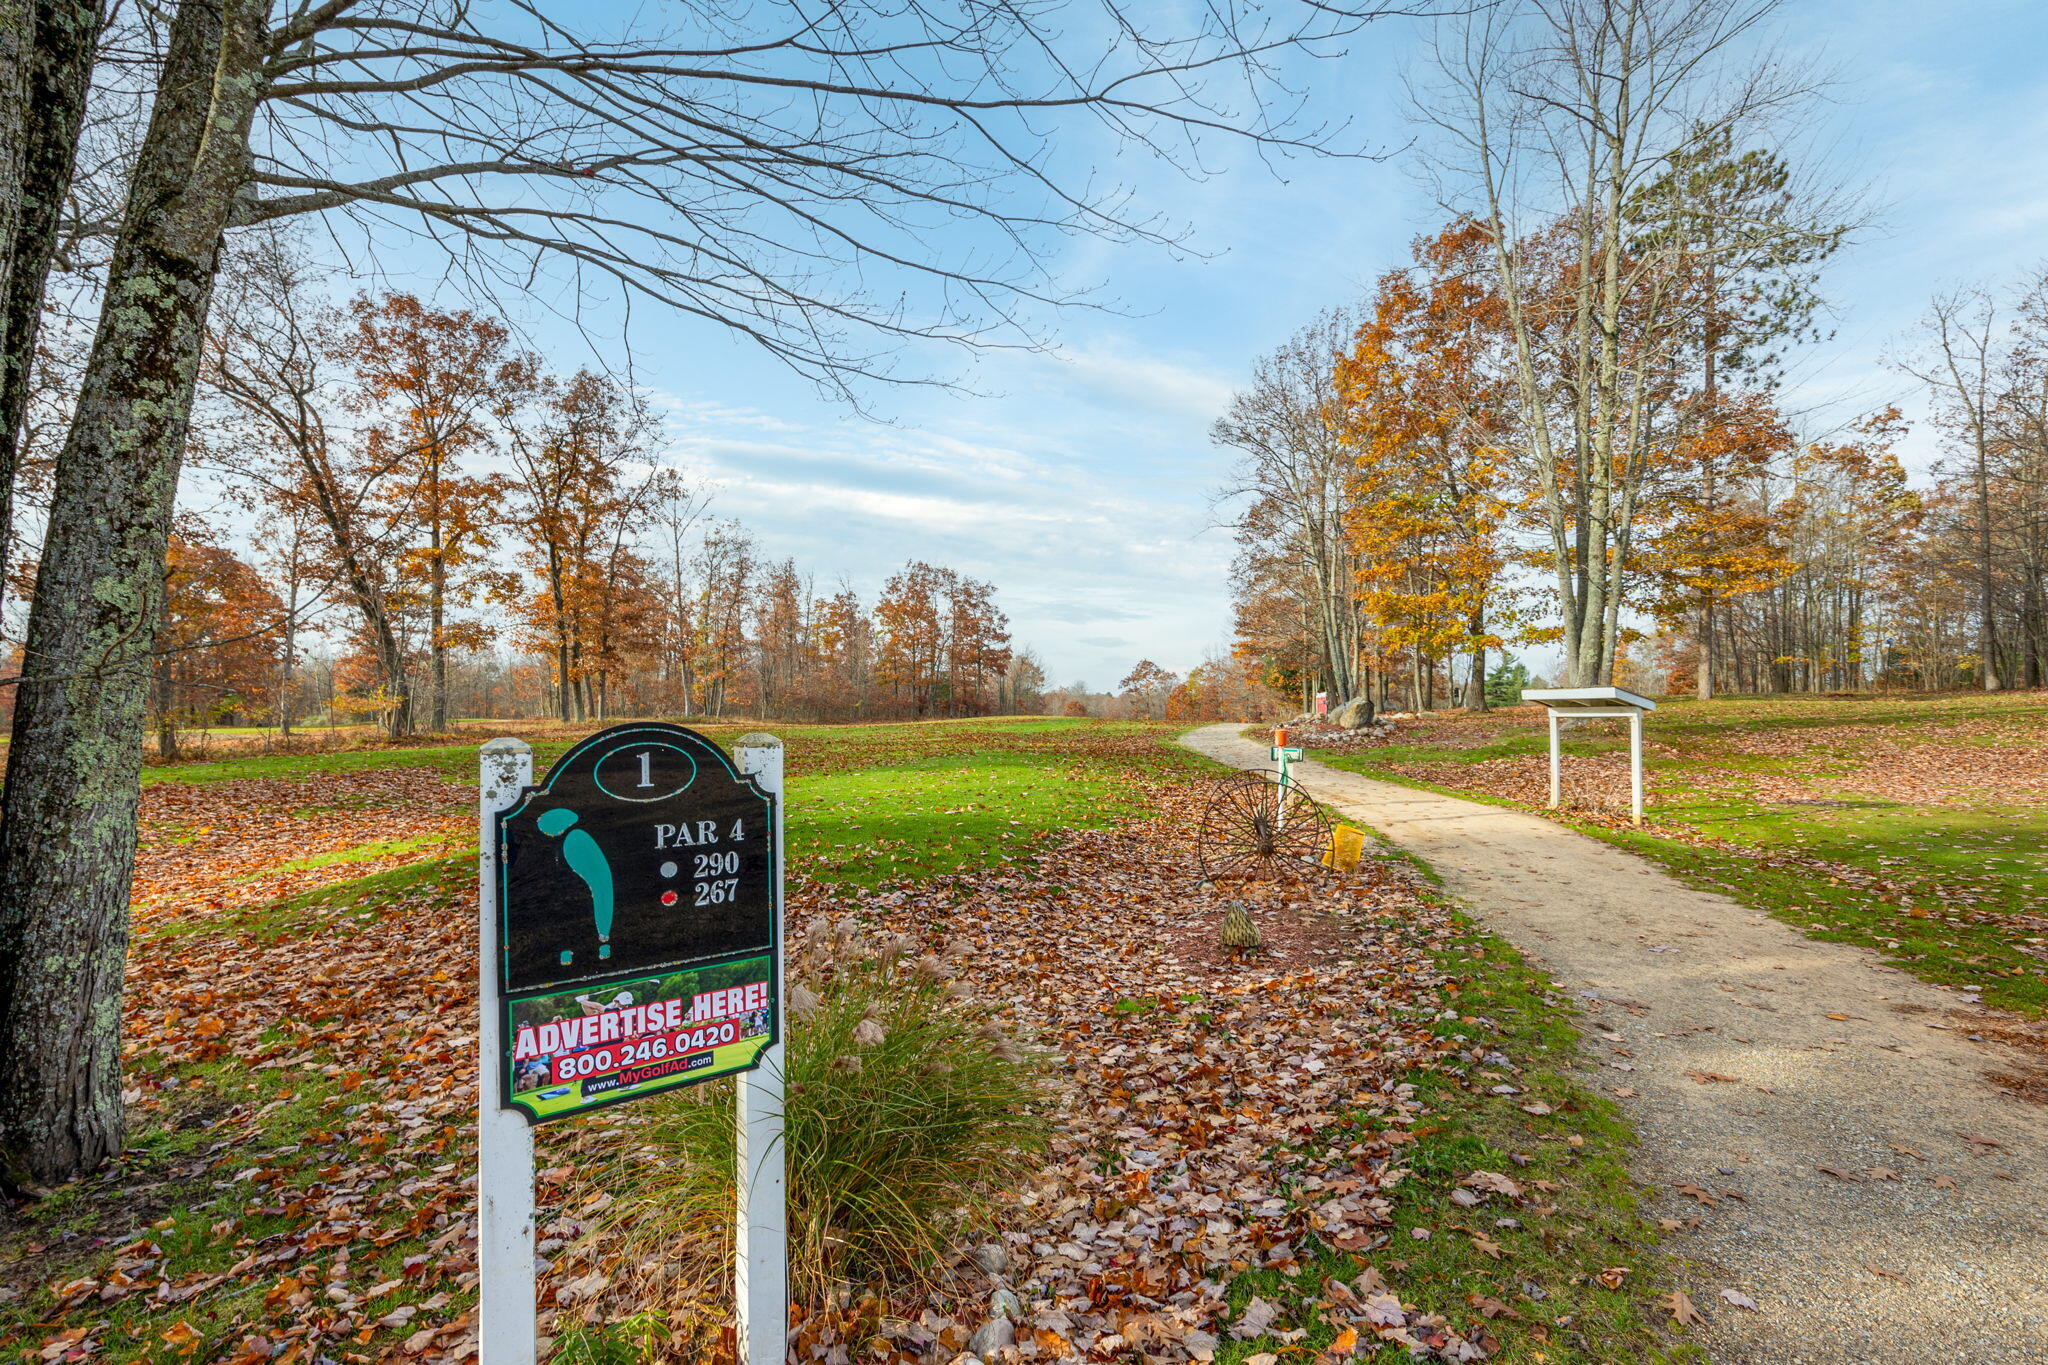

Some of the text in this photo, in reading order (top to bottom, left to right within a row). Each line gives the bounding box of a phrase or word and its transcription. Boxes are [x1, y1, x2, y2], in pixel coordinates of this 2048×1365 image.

[636, 751, 654, 787] 1
[655, 818, 744, 849] PAR 4
[694, 851, 740, 878] 290
[694, 878, 739, 906] 267
[515, 982, 768, 1059] ADVERTISE HERE!
[558, 1023, 734, 1080] 800.246.0420
[587, 1056, 713, 1093] www.MyGolfAd.com
